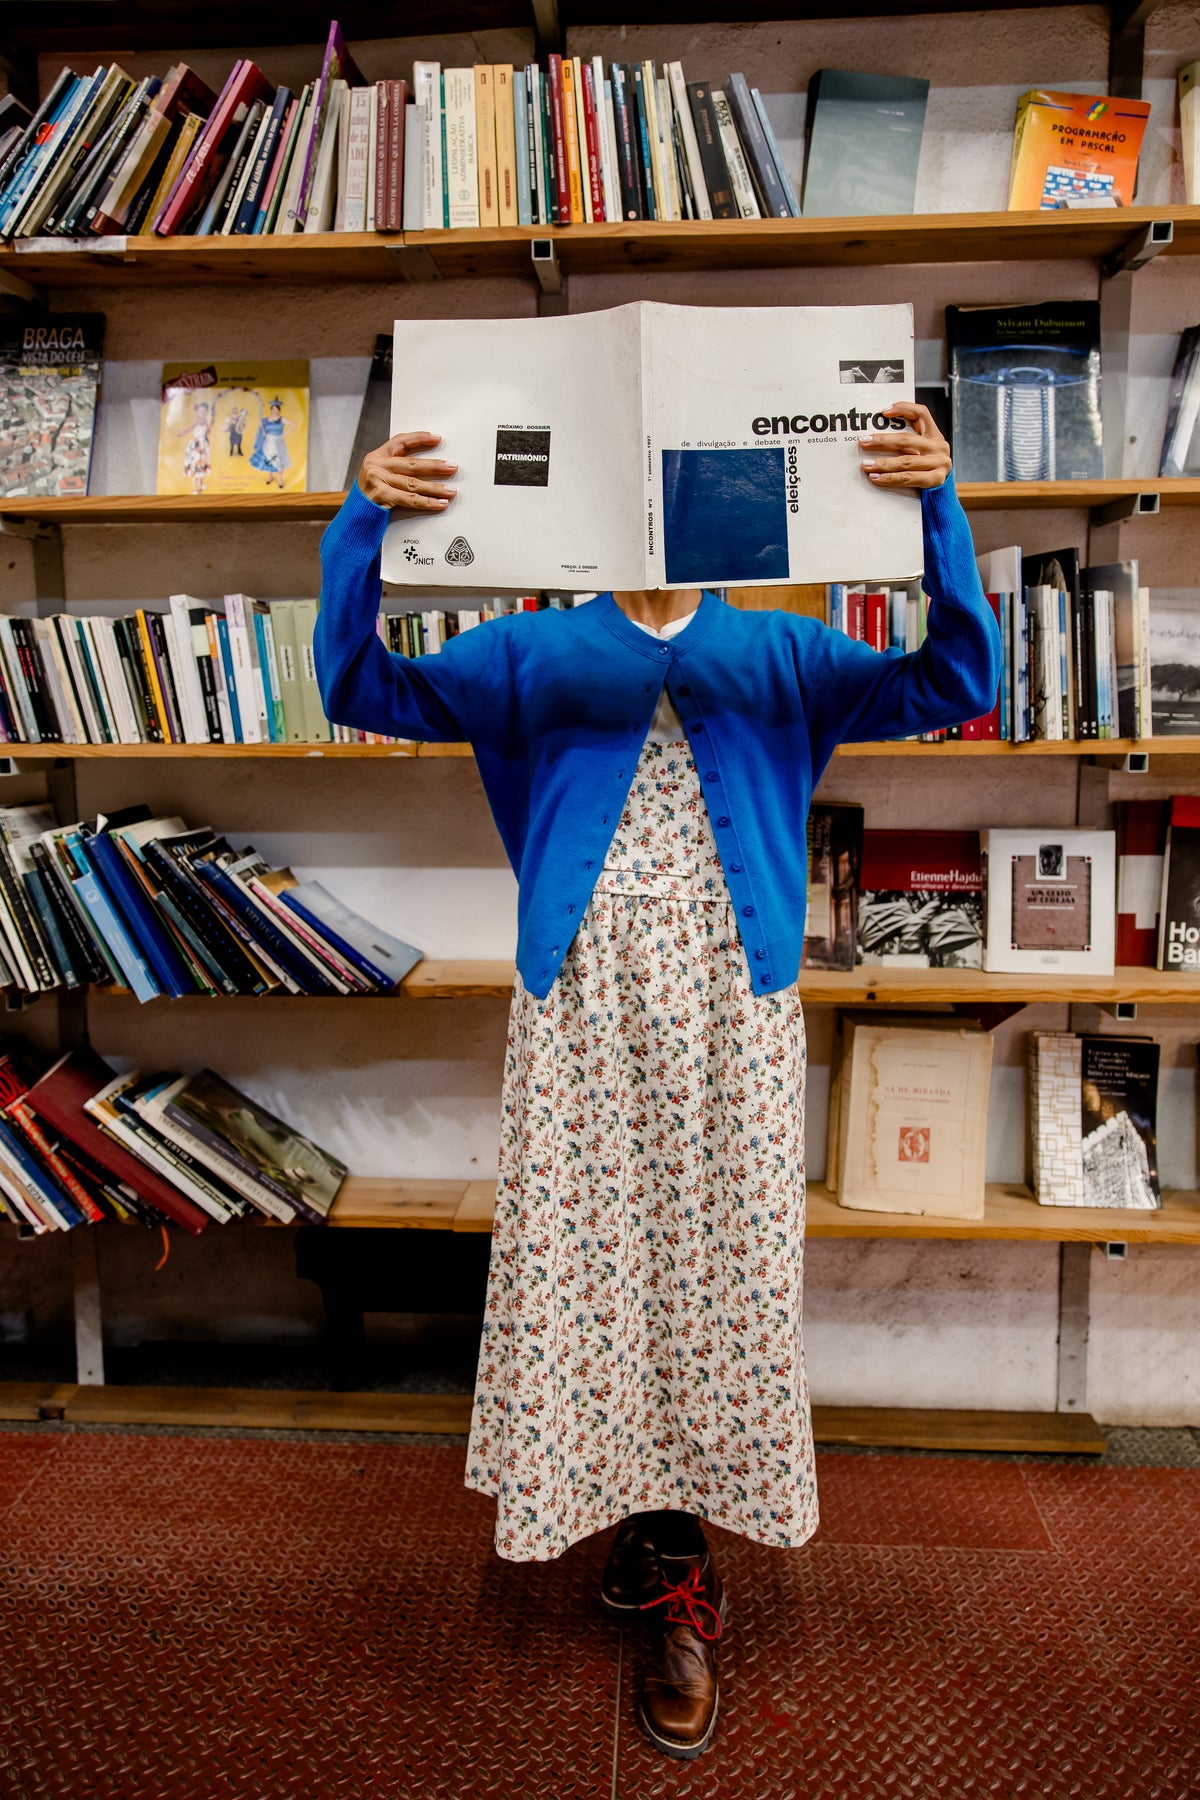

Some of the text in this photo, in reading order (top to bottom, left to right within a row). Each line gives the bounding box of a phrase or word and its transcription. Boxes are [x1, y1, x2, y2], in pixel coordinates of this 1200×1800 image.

[1052, 124, 1126, 143] PROGRAMAÇÃO
[1060, 136, 1115, 153] EM PASCAL
[391, 188, 396, 196] DE
[23, 327, 85, 349] BRAGA
[751, 407, 907, 436] encontros
[697, 440, 736, 449] divulgação
[808, 436, 837, 444] estudos
[497, 452, 548, 462] PATRIMÓNIO
[786, 446, 801, 513] eleições
[1170, 921, 1200, 944] Ho
[1168, 942, 1200, 963] Ba
